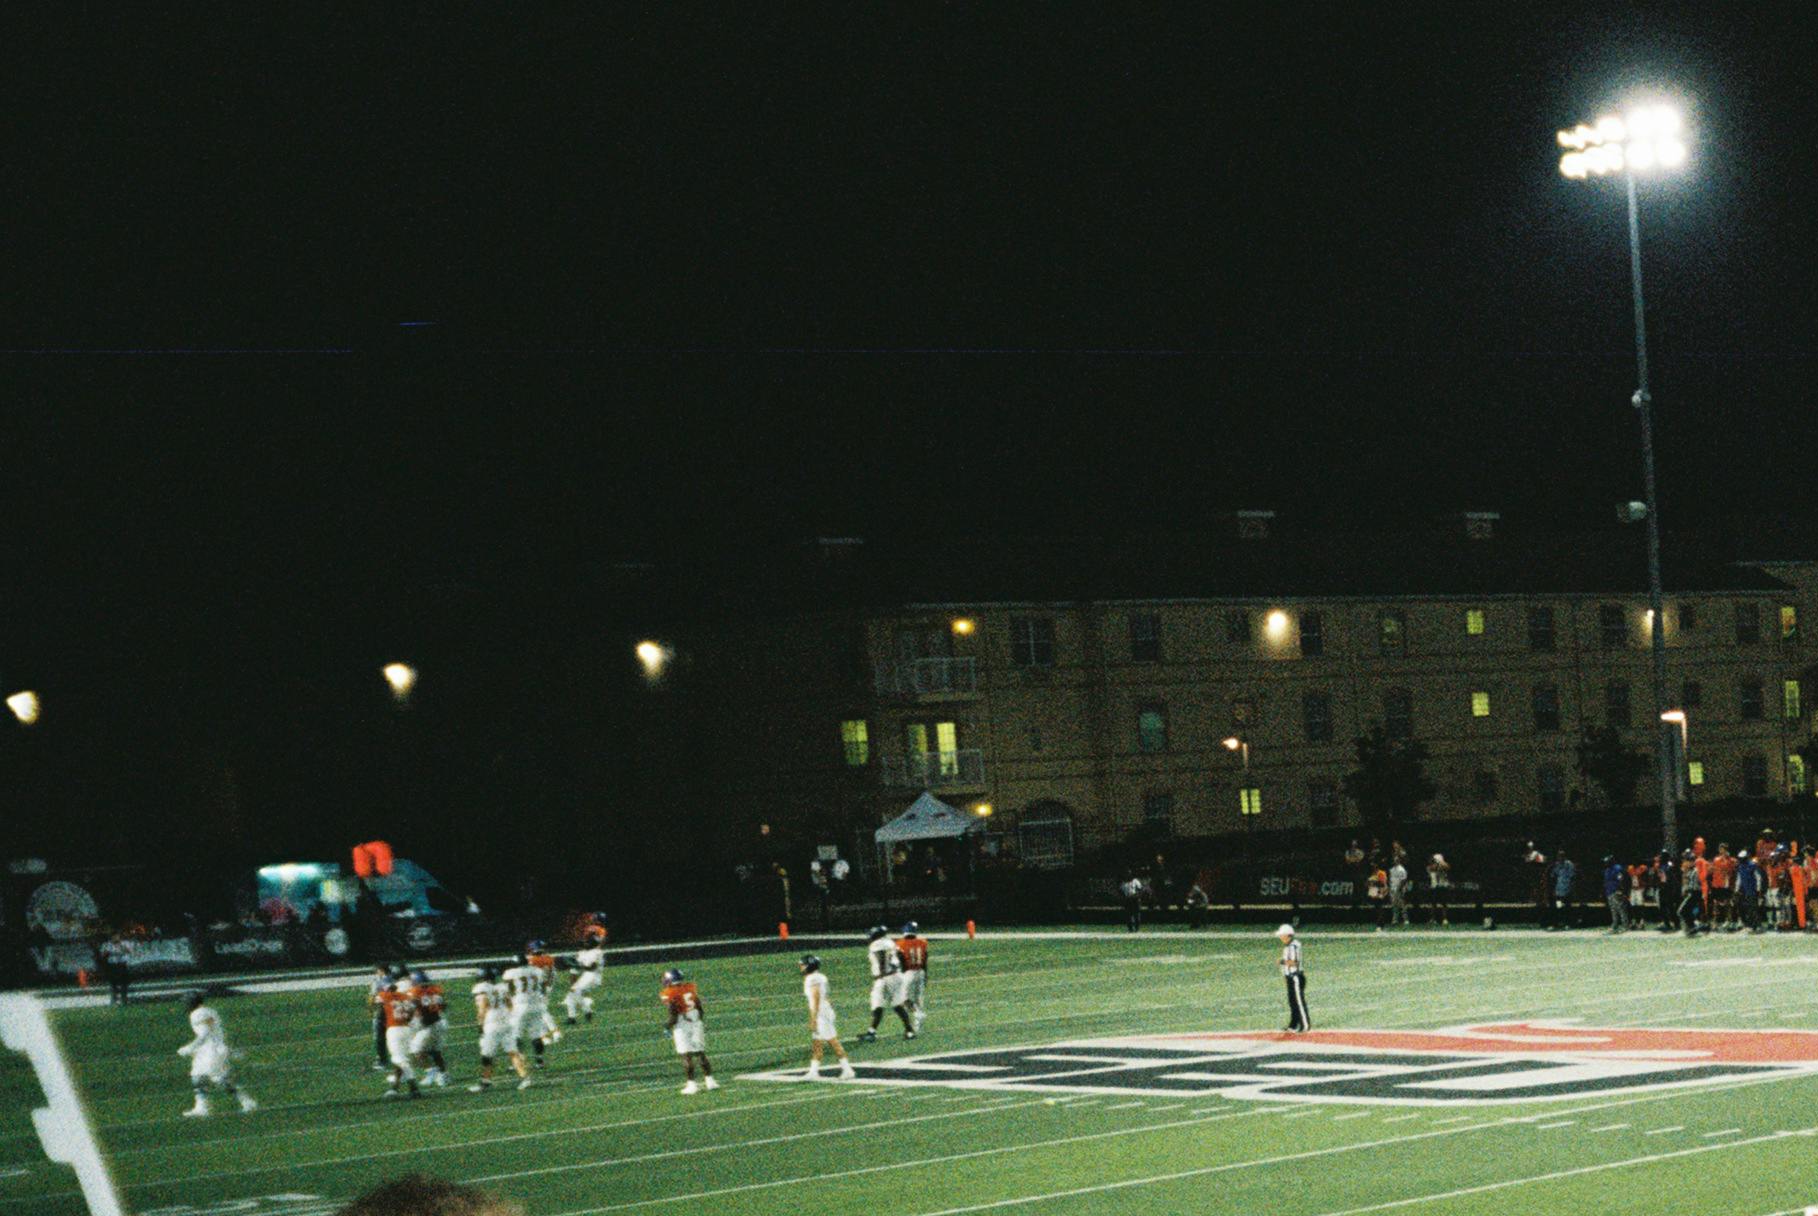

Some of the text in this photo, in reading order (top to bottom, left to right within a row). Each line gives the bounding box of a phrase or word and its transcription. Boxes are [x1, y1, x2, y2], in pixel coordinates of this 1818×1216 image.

[1260, 876, 1354, 896] SEU.com
[683, 992, 695, 1010] 5
[760, 1045, 1805, 1103] SEU
